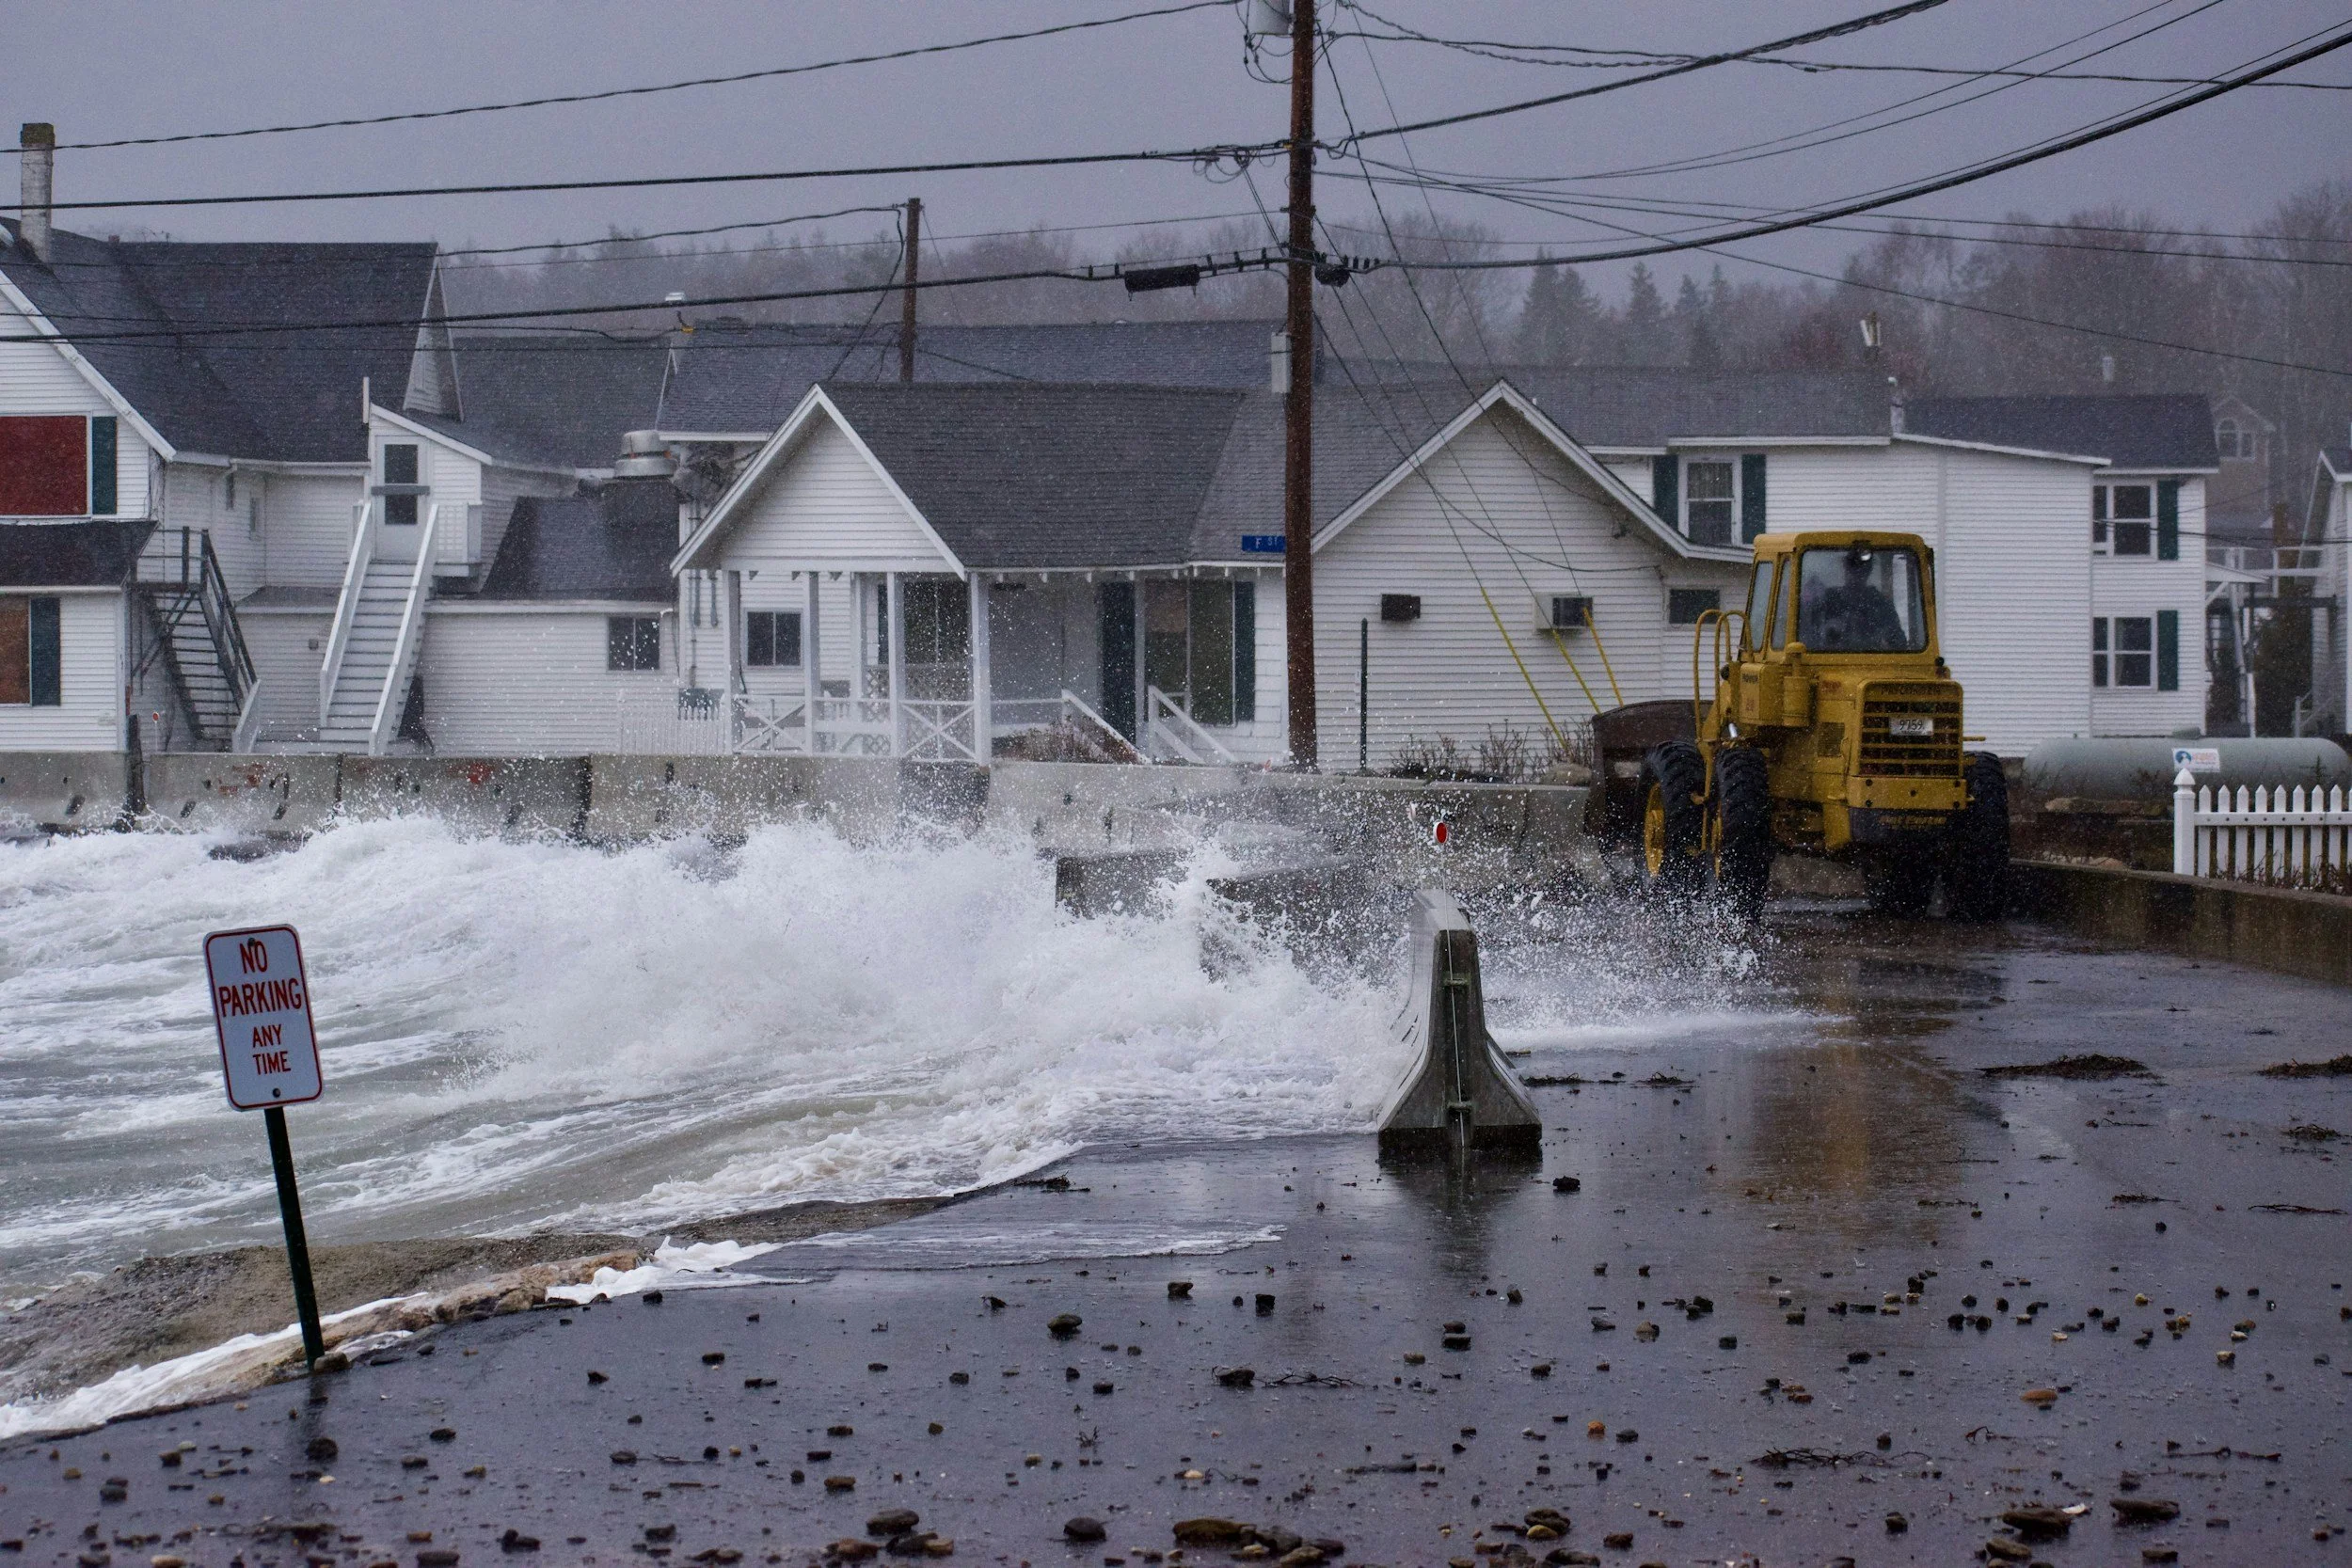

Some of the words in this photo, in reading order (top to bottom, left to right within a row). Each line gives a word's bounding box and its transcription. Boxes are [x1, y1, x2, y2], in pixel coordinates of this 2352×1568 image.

[1255, 537, 1263, 549] F
[239, 941, 268, 974] NO
[218, 977, 302, 1018] PARKING
[252, 1023, 282, 1049] ANY
[252, 1051, 292, 1075] TIME
